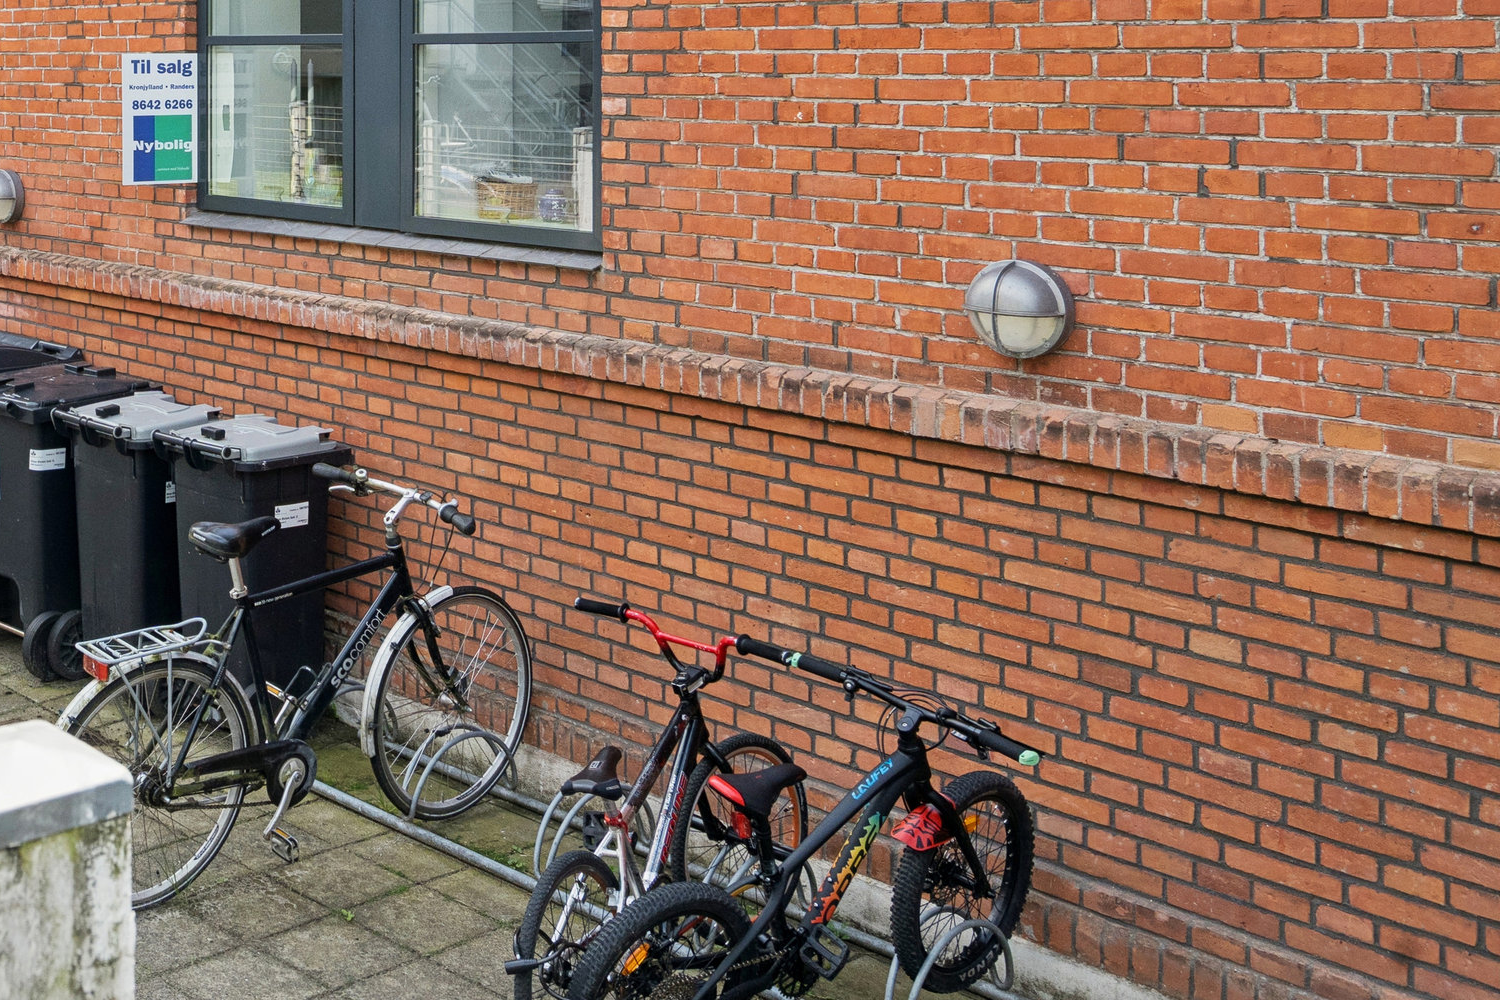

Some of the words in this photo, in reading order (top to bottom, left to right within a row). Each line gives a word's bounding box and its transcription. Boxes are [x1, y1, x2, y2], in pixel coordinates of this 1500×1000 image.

[131, 60, 151, 74] Til
[157, 59, 193, 77] salg
[132, 100, 161, 110] 8642
[164, 99, 193, 109] 6266
[132, 139, 193, 153] Nybolig
[851, 757, 895, 801] LAUFEY
[660, 770, 688, 865] REDLINE
